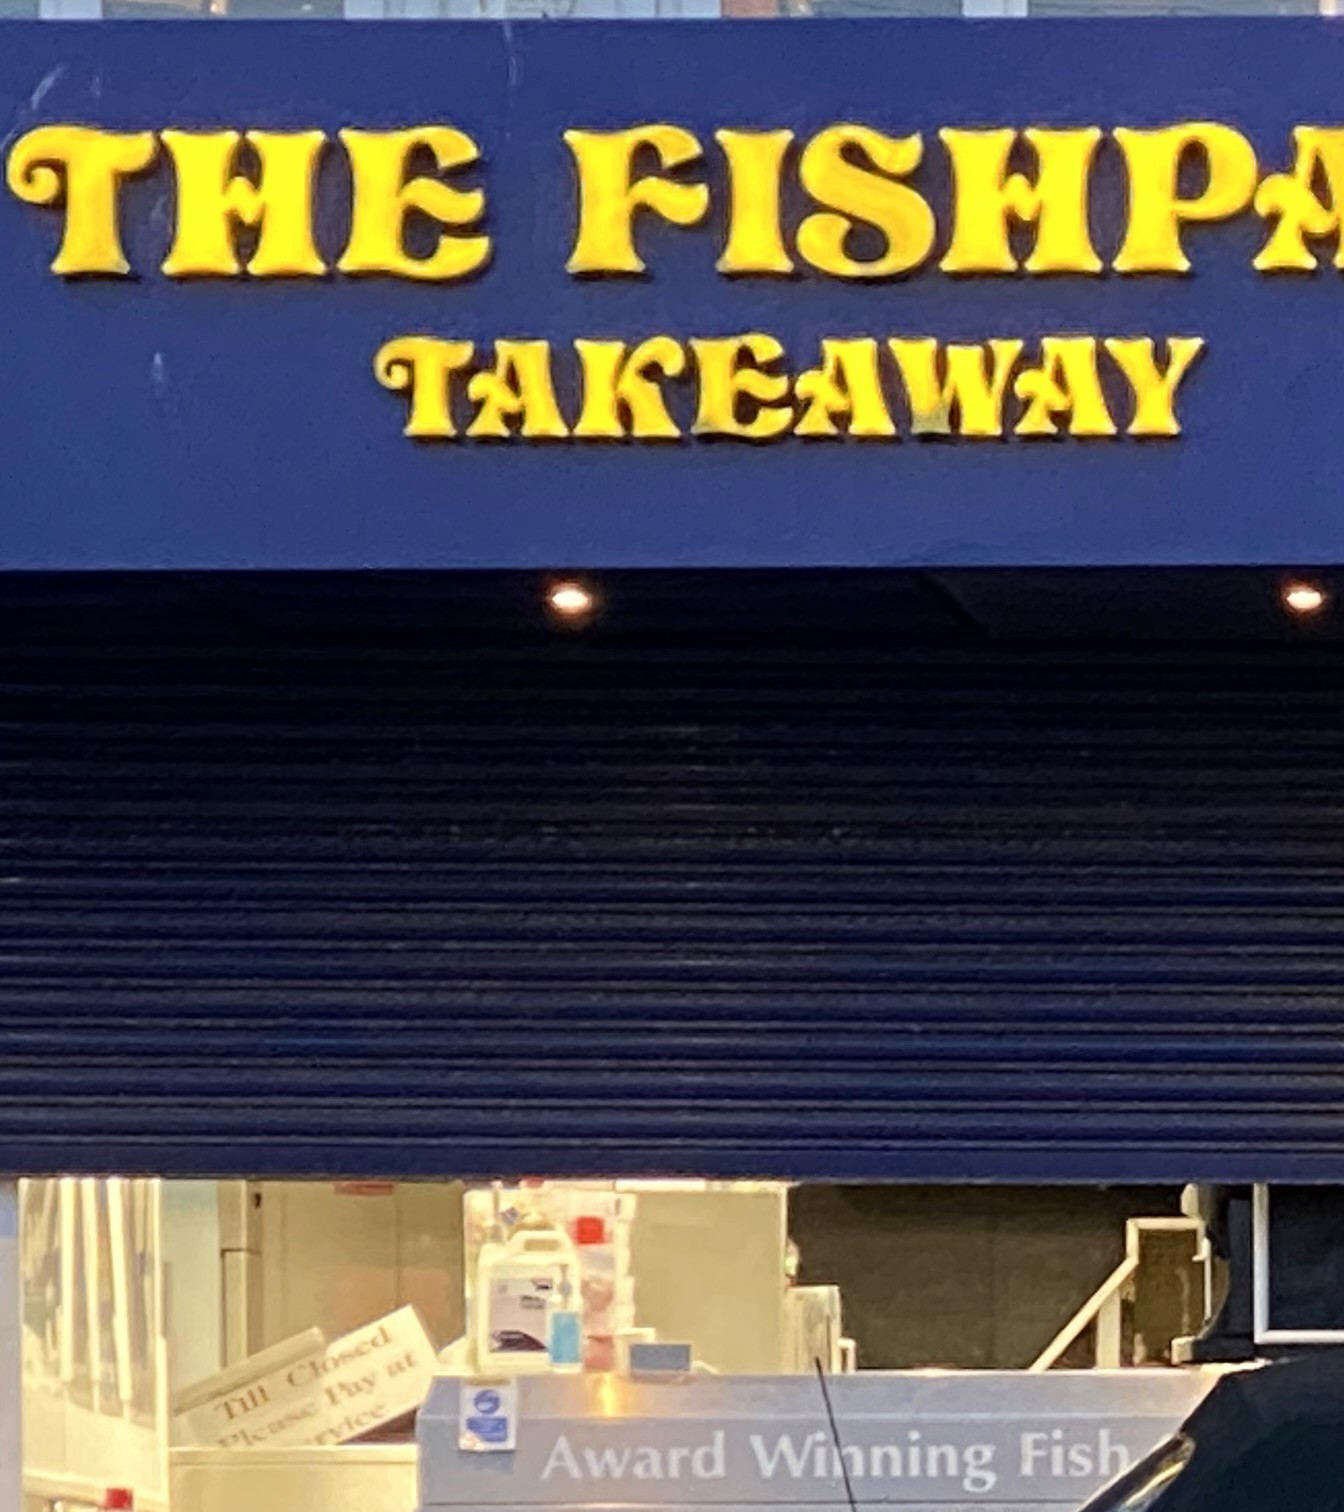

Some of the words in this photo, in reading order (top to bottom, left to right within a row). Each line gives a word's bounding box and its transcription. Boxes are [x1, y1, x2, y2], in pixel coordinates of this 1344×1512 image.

[7, 124, 491, 280] THE
[374, 332, 1204, 438] TAKEAWAY
[213, 1384, 270, 1420] Till
[286, 1325, 392, 1388] Closed
[324, 1370, 378, 1406] Pay
[541, 1430, 727, 1480] Award
[750, 1431, 998, 1493] Winning
[1019, 1429, 1130, 1478] Fish
